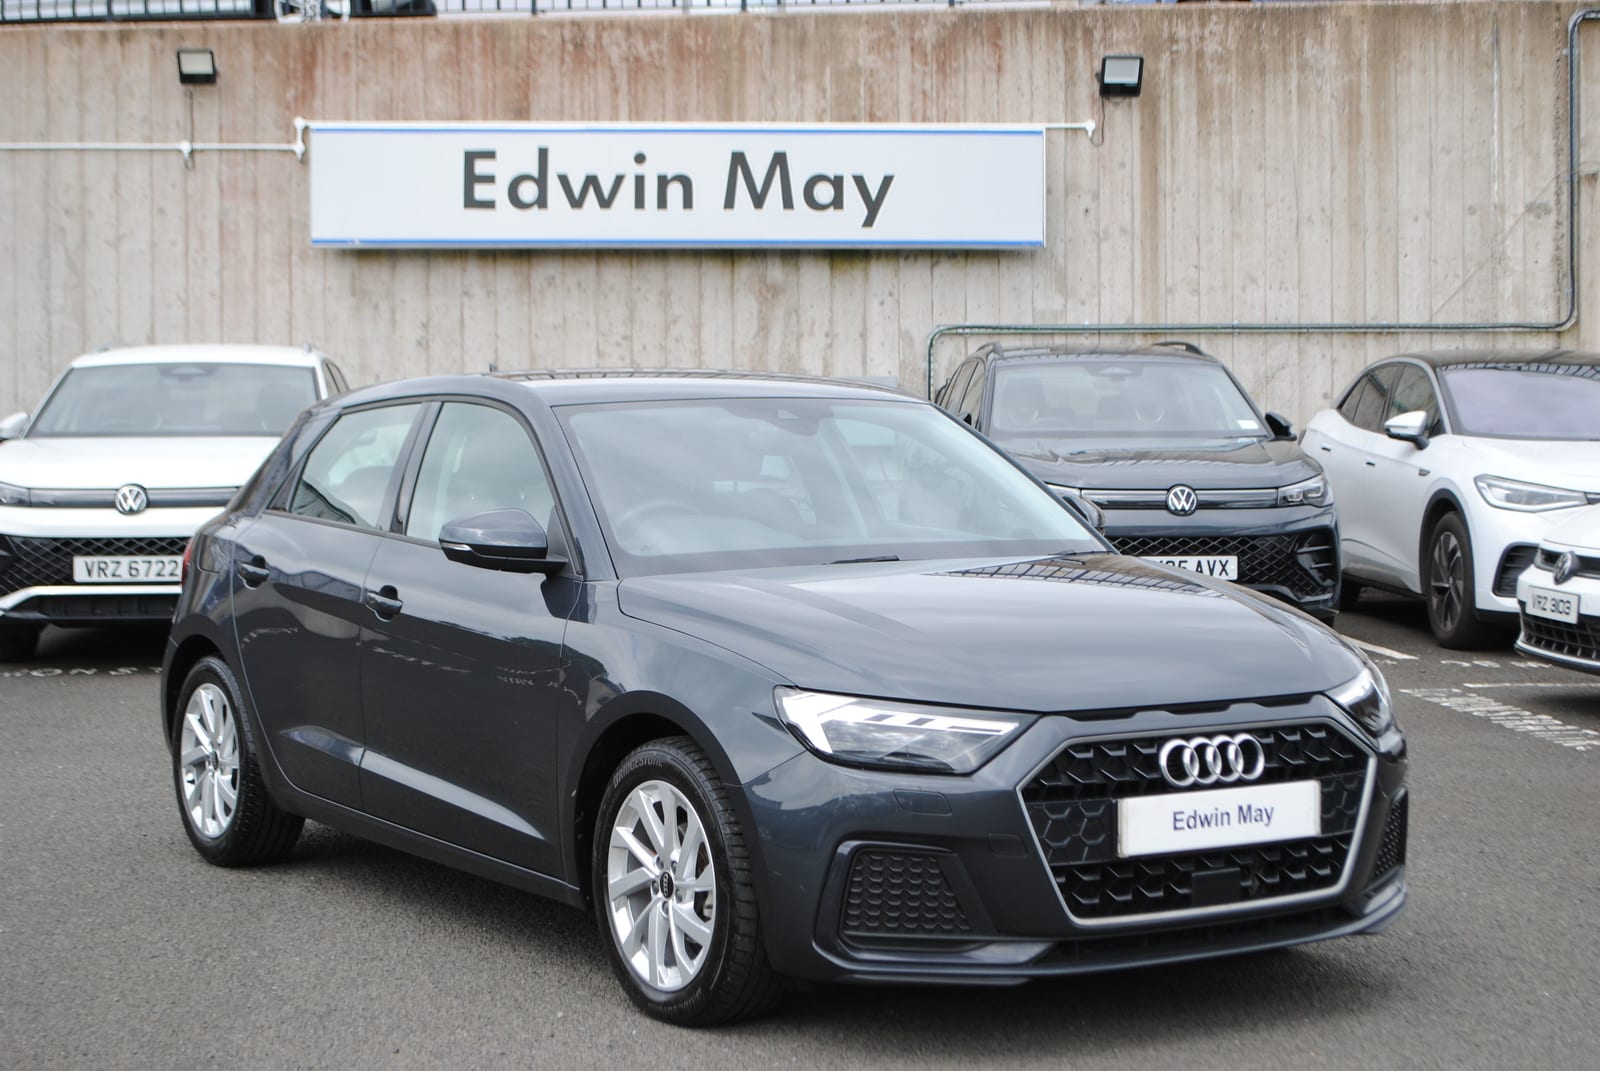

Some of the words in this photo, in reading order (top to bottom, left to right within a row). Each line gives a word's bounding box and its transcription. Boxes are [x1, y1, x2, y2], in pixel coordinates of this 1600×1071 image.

[463, 146, 694, 210] Edwin
[723, 150, 895, 228] May
[84, 560, 121, 578] VRZ
[128, 560, 179, 577] 6722
[1195, 560, 1229, 576] AVX
[1532, 593, 1548, 611] VRZ
[1172, 807, 1231, 831] Edwin
[1237, 804, 1274, 827] May
